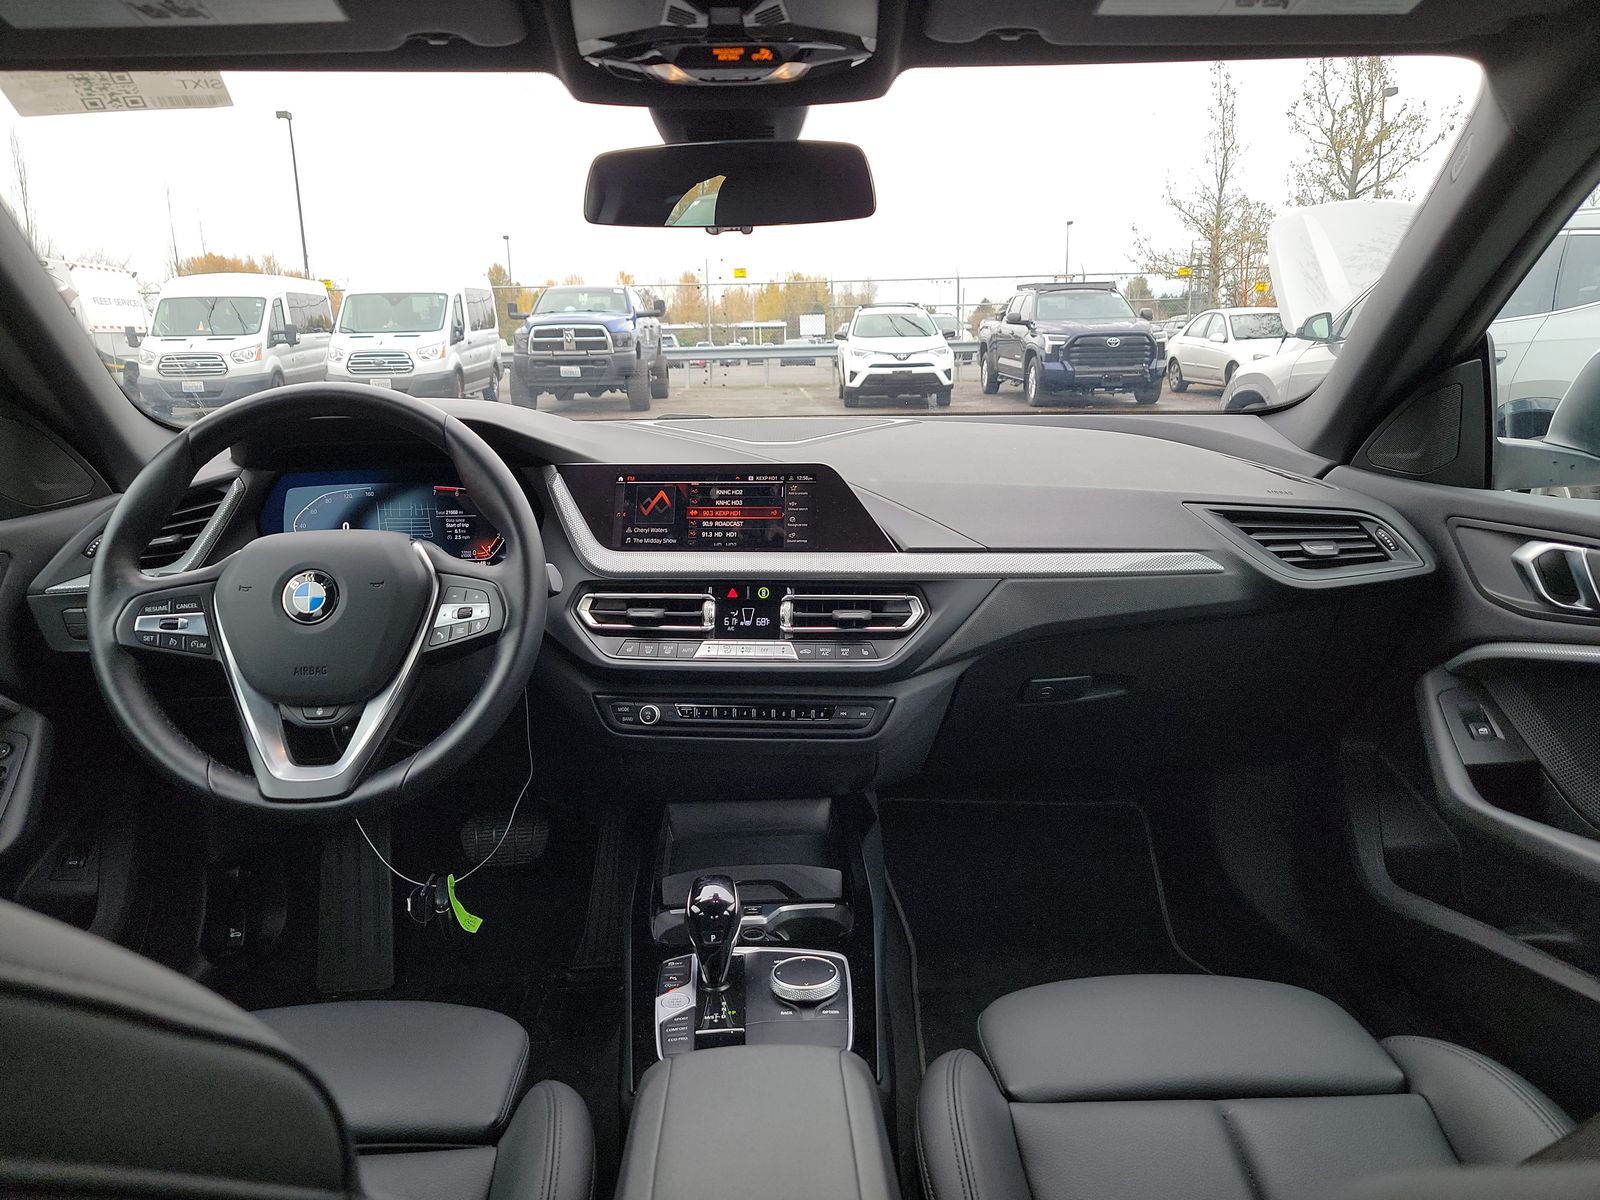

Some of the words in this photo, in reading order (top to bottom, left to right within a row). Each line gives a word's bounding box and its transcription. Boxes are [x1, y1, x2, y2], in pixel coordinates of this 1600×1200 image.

[92, 296, 112, 305] FLEET
[113, 298, 142, 307] SERVICES
[715, 499, 731, 507] KNHC
[731, 499, 743, 507] HD3
[293, 666, 327, 676] AIRBAG
[710, 934, 716, 942] P
